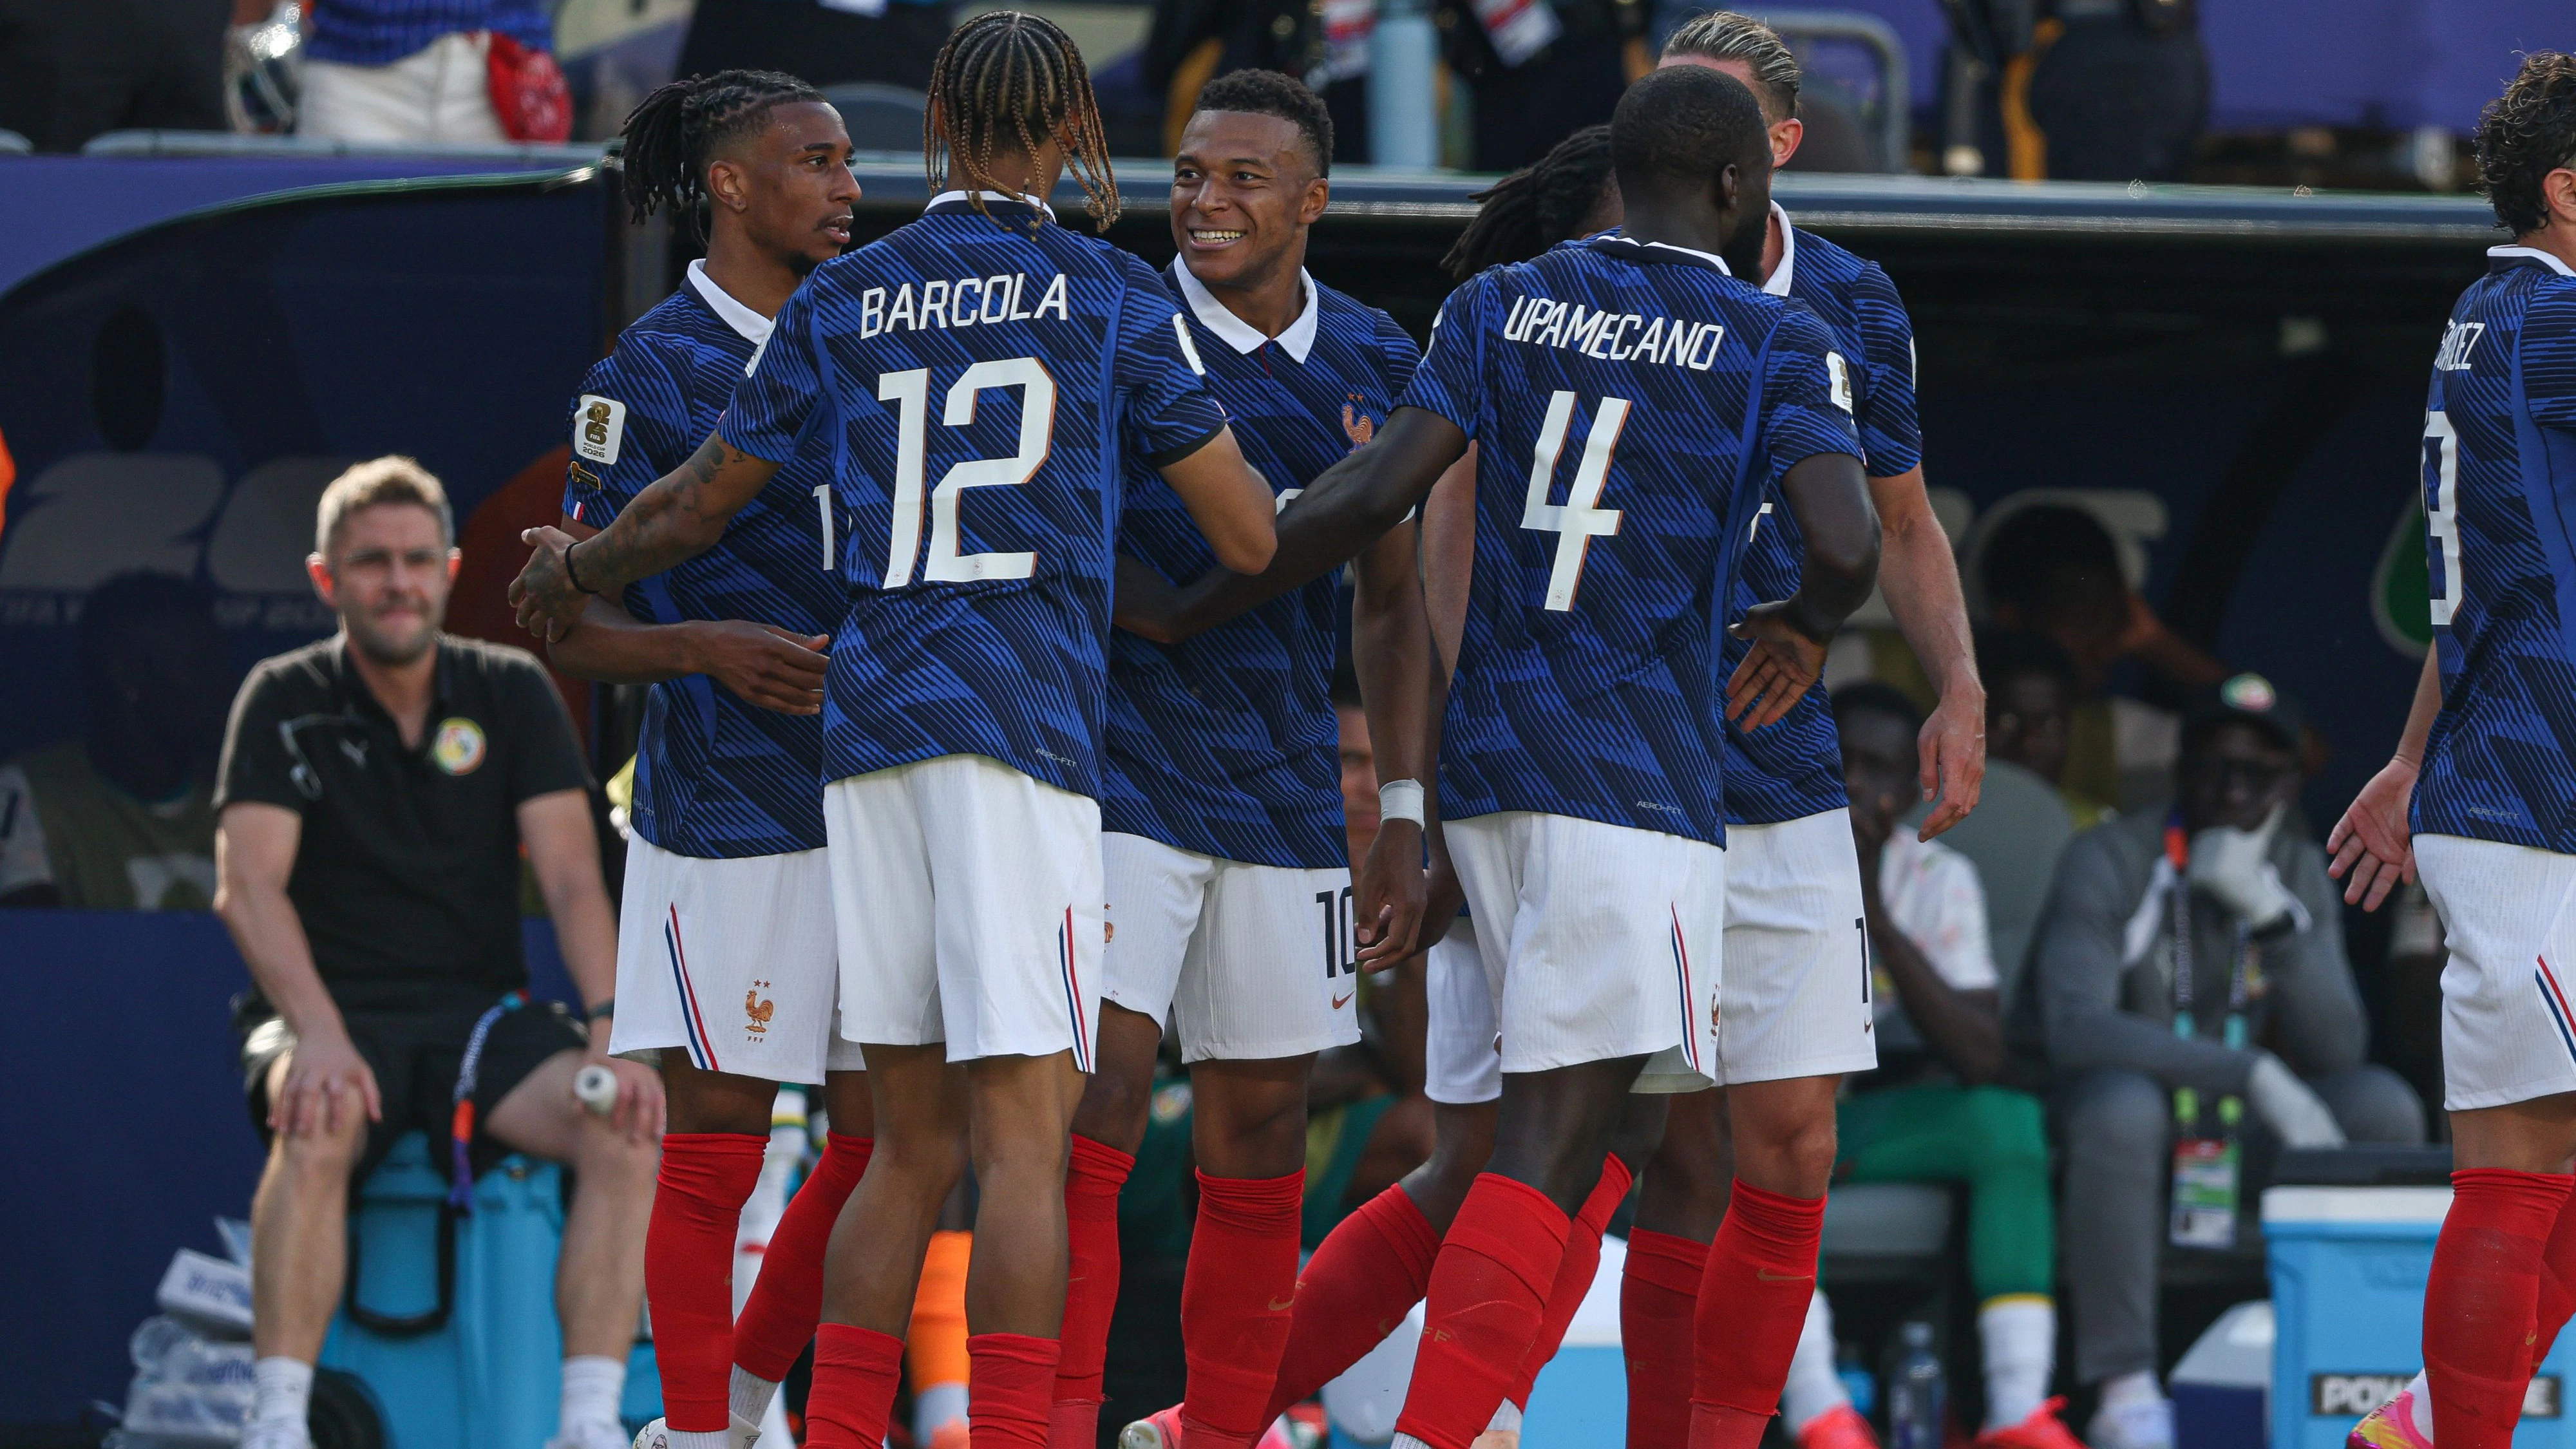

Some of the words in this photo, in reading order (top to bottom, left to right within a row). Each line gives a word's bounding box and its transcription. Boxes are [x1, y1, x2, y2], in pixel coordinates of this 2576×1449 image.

[860, 272, 1069, 339] BARCOLA
[1504, 295, 1725, 371] UPAMECANO
[583, 446, 605, 458] 2026
[878, 357, 1057, 589] 12
[1520, 390, 1632, 612] 4
[1036, 748, 1077, 768] AERO-FIT
[1636, 800, 1681, 814] AERO-FIT
[2468, 807, 2519, 820] AERO-FIT
